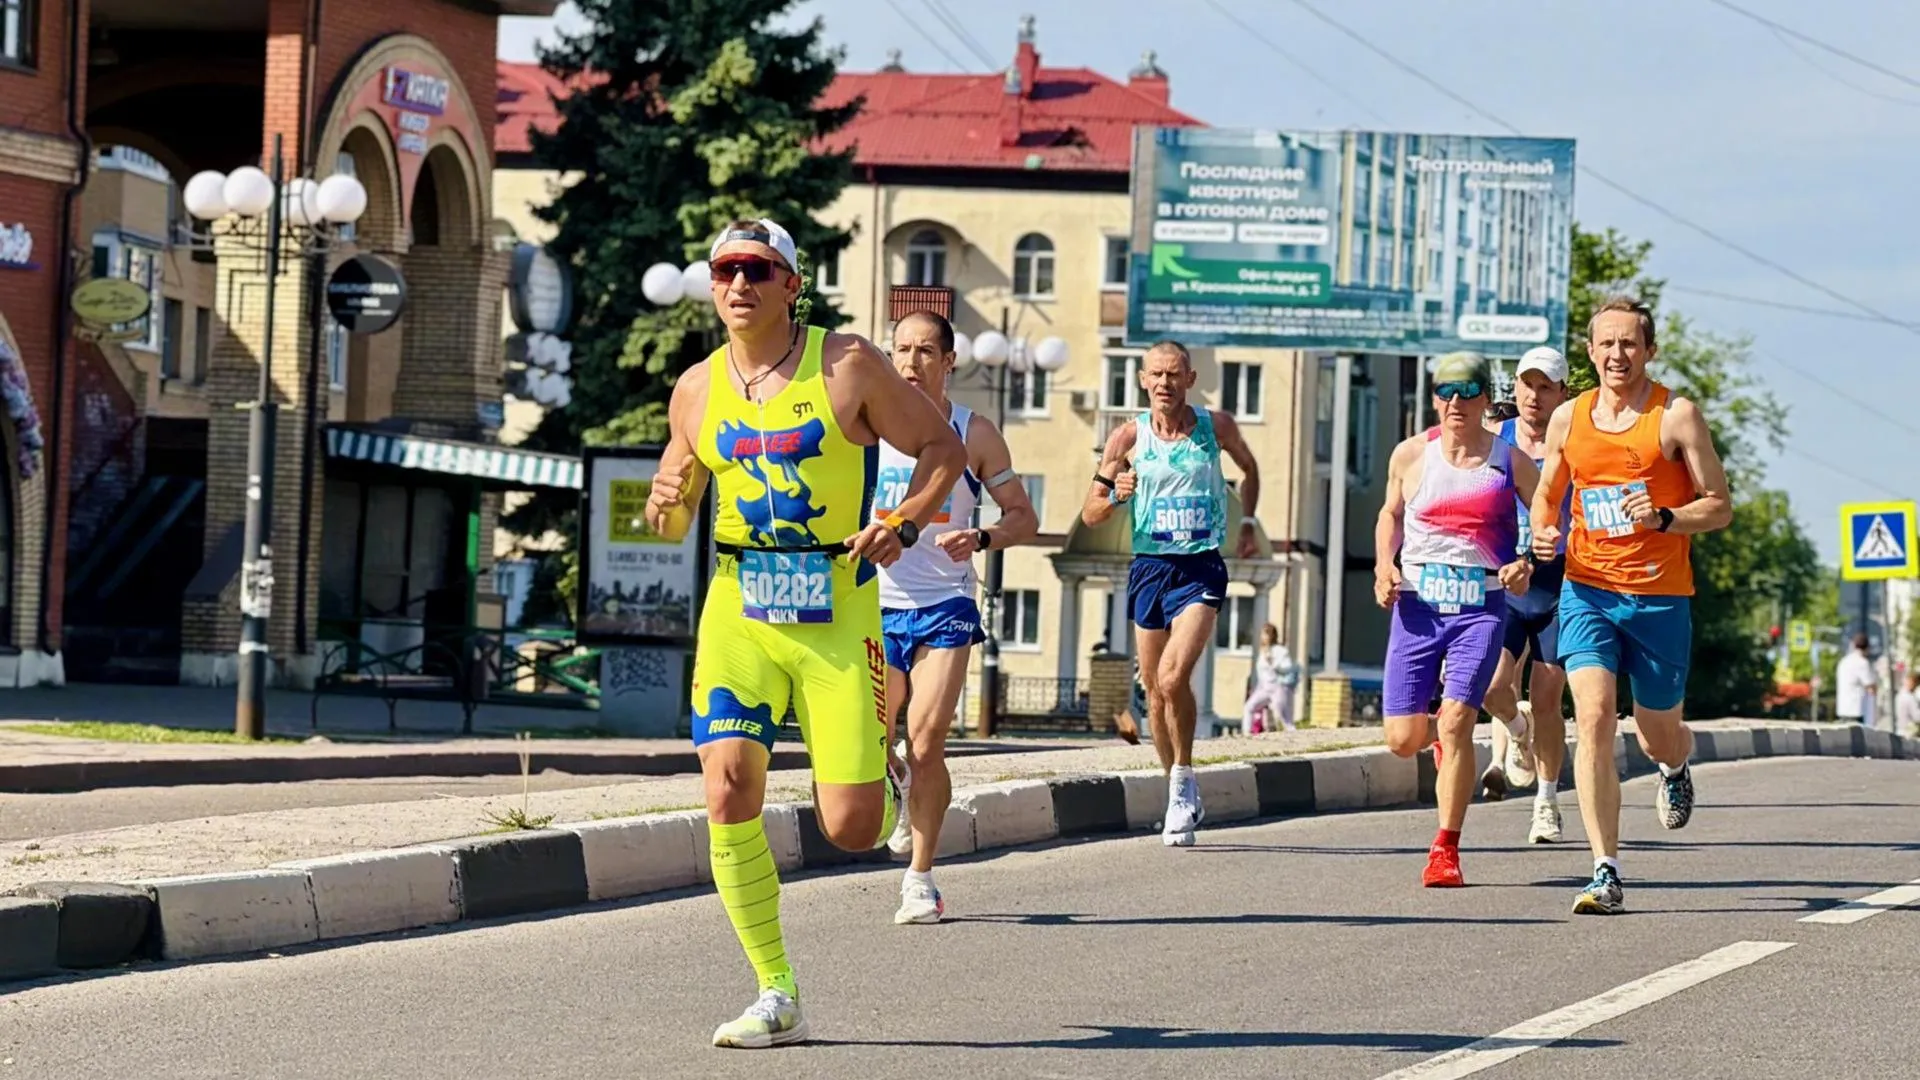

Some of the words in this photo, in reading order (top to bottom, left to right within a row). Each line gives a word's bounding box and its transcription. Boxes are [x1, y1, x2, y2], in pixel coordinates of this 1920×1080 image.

[1180, 161, 1305, 181] Последние
[1407, 156, 1554, 175] Театральный
[1188, 184, 1300, 202] квартиры
[1158, 203, 1172, 216] в
[1175, 203, 1266, 219] готовом
[1269, 205, 1329, 221] доме
[1155, 508, 1207, 530] 50182
[742, 570, 826, 606] 50282
[1423, 577, 1480, 604] 50310
[767, 609, 799, 623] 10KM
